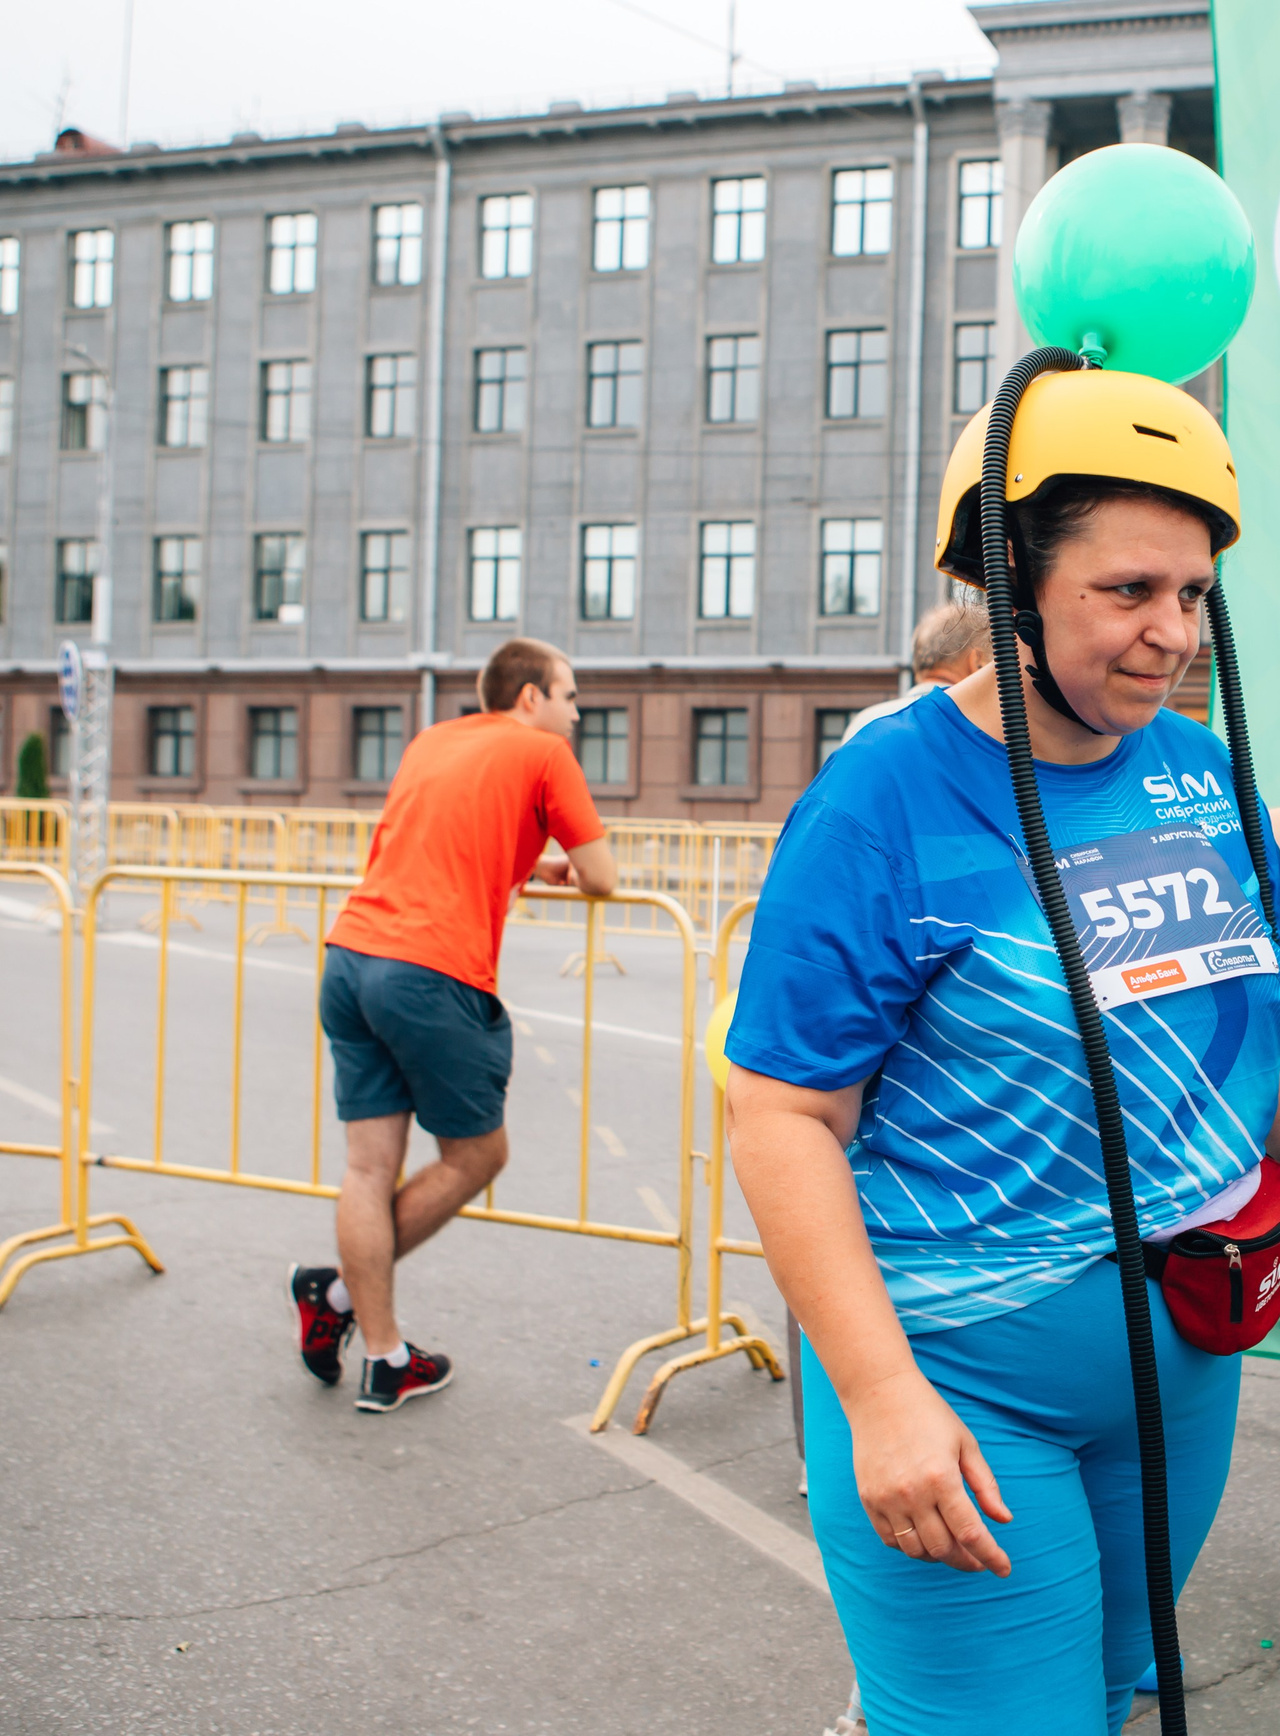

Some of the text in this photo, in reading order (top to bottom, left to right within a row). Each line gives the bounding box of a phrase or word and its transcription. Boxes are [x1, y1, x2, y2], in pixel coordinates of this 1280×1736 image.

[1155, 797, 1232, 819] СИБРСКИЙ
[1150, 836, 1158, 844] 3
[1159, 830, 1195, 843] АВГУСТА
[1079, 868, 1233, 938] 5572
[1215, 954, 1255, 968] Следопыт
[1129, 967, 1180, 986] Альфа Банк
